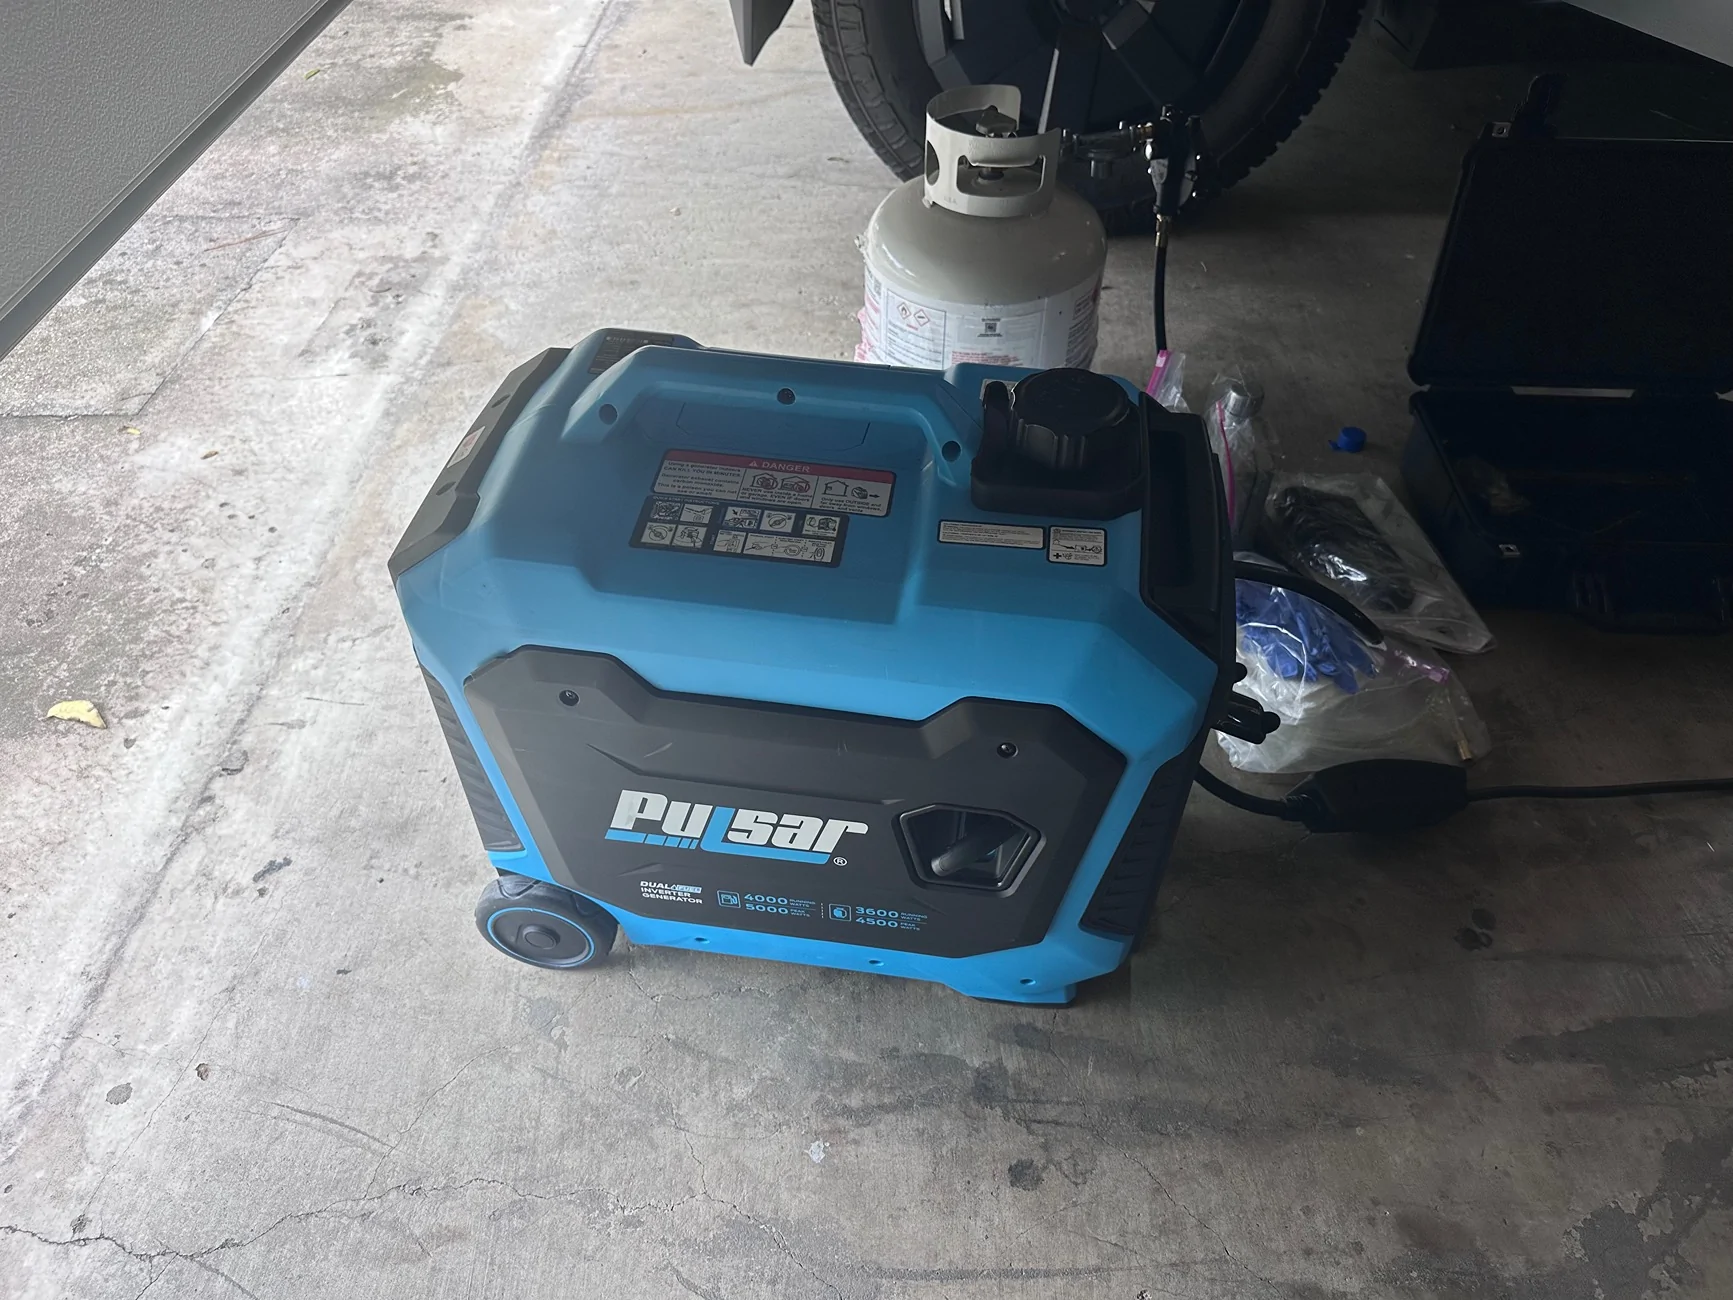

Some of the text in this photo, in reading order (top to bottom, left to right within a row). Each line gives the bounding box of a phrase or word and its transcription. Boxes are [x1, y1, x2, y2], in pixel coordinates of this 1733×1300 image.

[761, 461, 811, 473] DANGER
[640, 880, 671, 890] DUAL
[640, 886, 692, 898] INVERTER
[642, 892, 703, 904] GENERATOR
[744, 893, 788, 906] 4000
[745, 903, 788, 914] 5000
[856, 906, 899, 918] 3600
[856, 916, 898, 928] 4500
